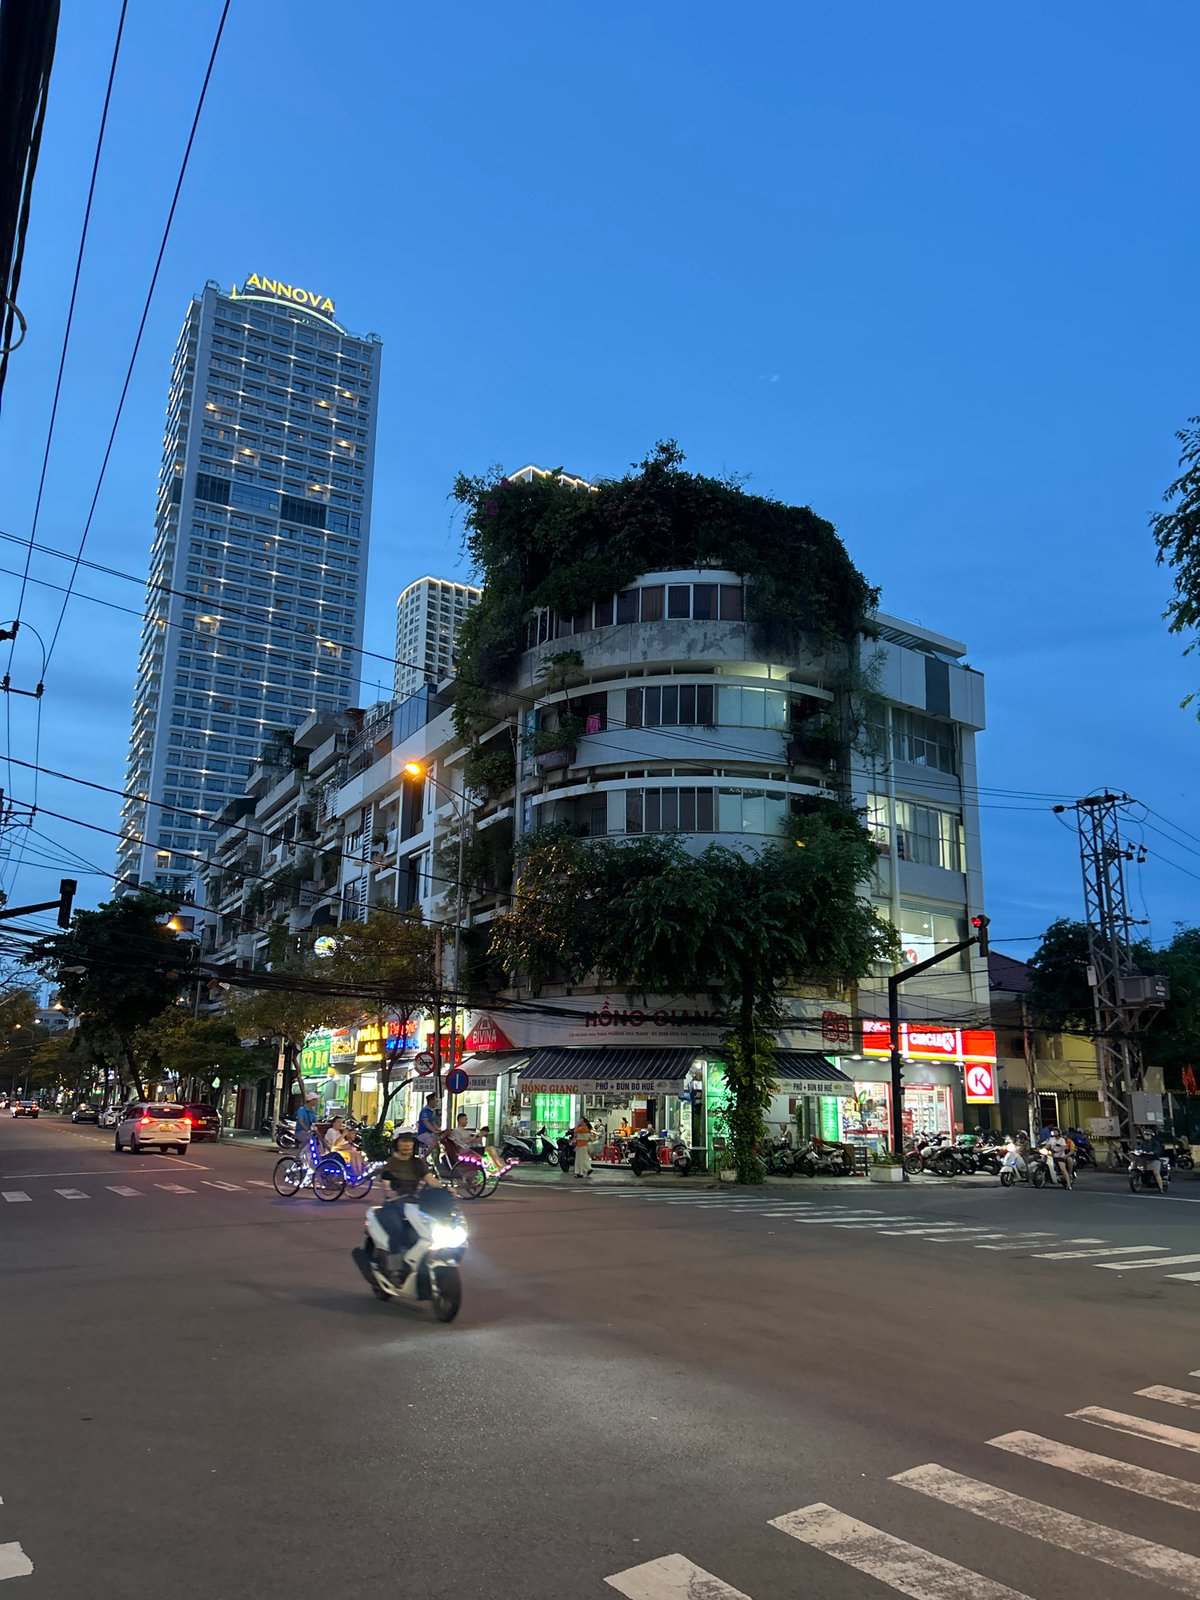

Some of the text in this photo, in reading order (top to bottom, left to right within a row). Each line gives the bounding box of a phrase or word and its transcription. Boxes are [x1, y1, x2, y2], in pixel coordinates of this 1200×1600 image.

[246, 272, 335, 313] ANNOVA
[472, 1029, 497, 1044] BIVINA
[909, 1033, 943, 1048] CIRCLE
[549, 1084, 579, 1093] GIANG
[595, 1081, 609, 1090] PHỞ
[974, 1073, 990, 1092] K
